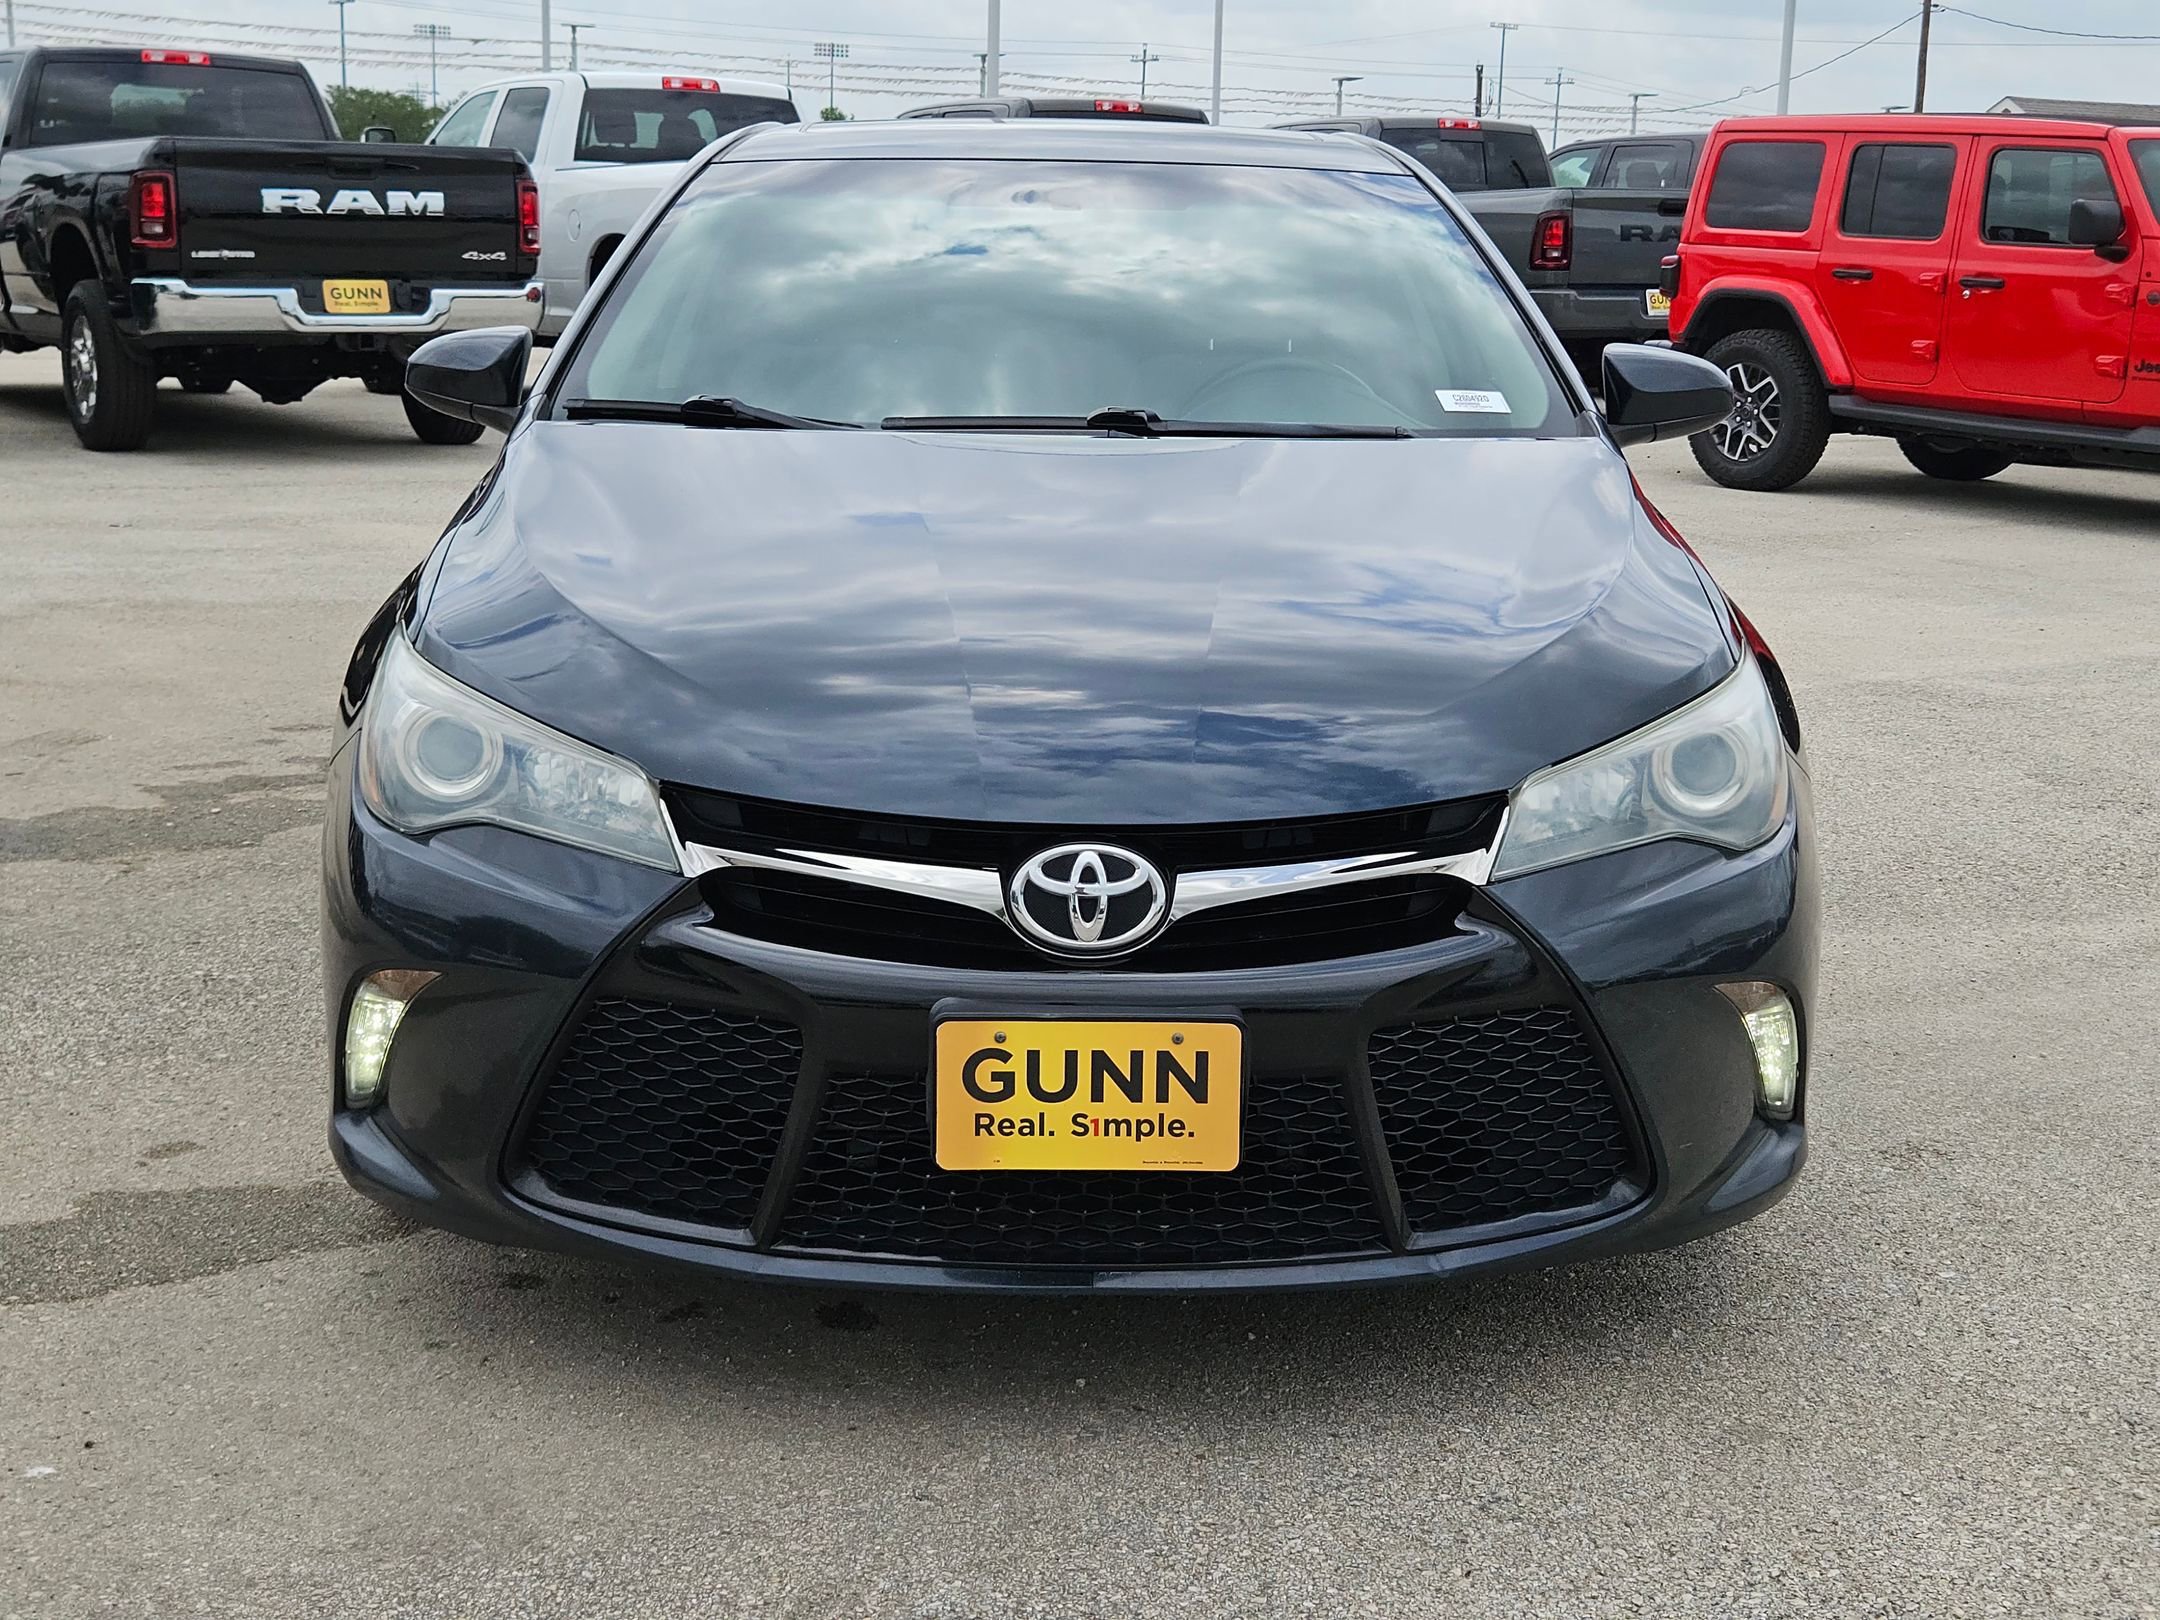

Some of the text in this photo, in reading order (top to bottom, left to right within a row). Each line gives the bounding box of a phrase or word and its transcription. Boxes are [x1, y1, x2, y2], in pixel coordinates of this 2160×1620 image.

[260, 188, 445, 216] RAM
[1620, 225, 1681, 241] RA
[461, 251, 507, 261] 4x4
[330, 287, 383, 300] GUNN
[1650, 294, 1671, 304] GUN
[2134, 358, 2160, 373] Jee
[961, 1047, 1209, 1104] GUNN
[973, 1112, 1056, 1138] Real.
